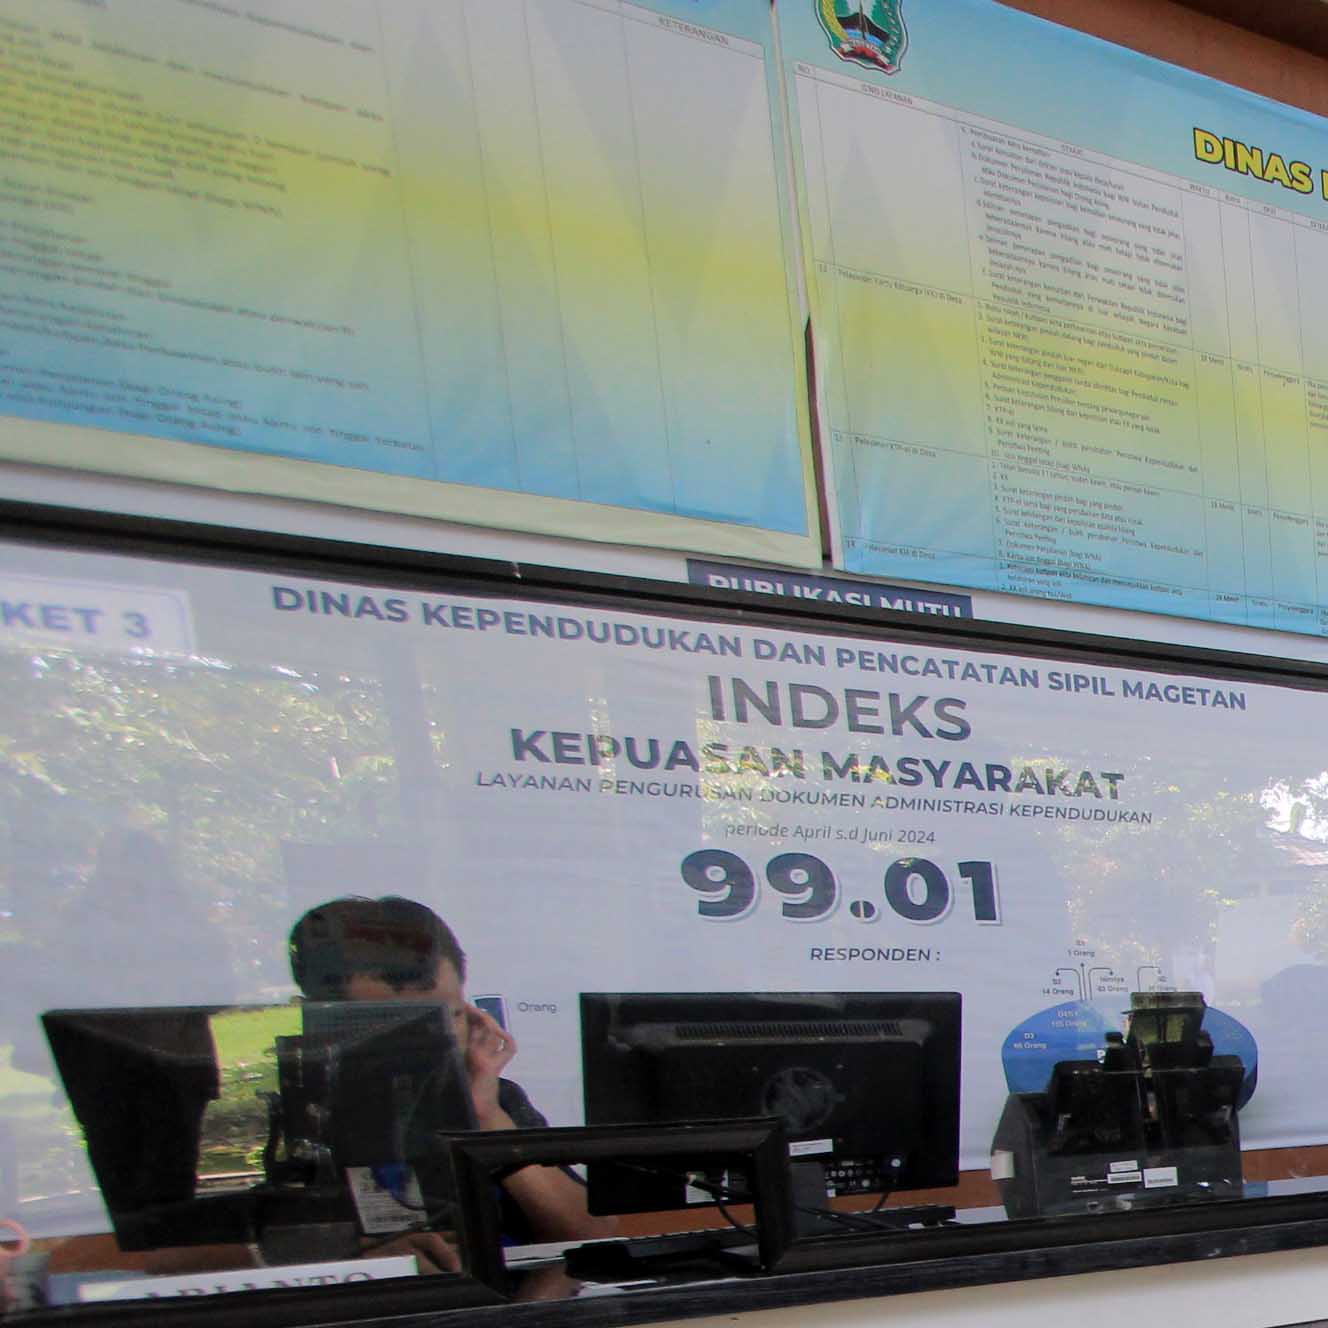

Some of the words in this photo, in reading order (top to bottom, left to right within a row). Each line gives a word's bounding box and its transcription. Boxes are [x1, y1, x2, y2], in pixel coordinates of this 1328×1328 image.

[1193, 127, 1314, 194] DINAS
[123, 611, 152, 639] 3
[272, 585, 409, 622] DINAS
[423, 603, 742, 657] KEPENDUDUKAN
[754, 637, 826, 668] DAN
[837, 647, 1040, 690] PENCATATAN
[1048, 671, 1116, 698] SIPIL
[1122, 679, 1247, 711] MAGETAN
[706, 675, 973, 741] INDEKS
[509, 727, 805, 780] KEPUASAN
[822, 750, 1126, 801] MASYARAKAT
[476, 771, 592, 794] LAYANAN
[599, 778, 753, 803] PENGURUSAN
[760, 787, 865, 809] DOKUMEN
[872, 795, 1004, 817] ADMINISTRASI
[1009, 802, 1153, 825] KEPENDUDUKAN
[793, 824, 832, 843] April
[860, 826, 893, 845] Juni
[897, 828, 936, 845] 2024
[680, 848, 1006, 927] 99.01
[810, 946, 932, 962] RESPONDEN
[517, 1001, 558, 1014] Orang
